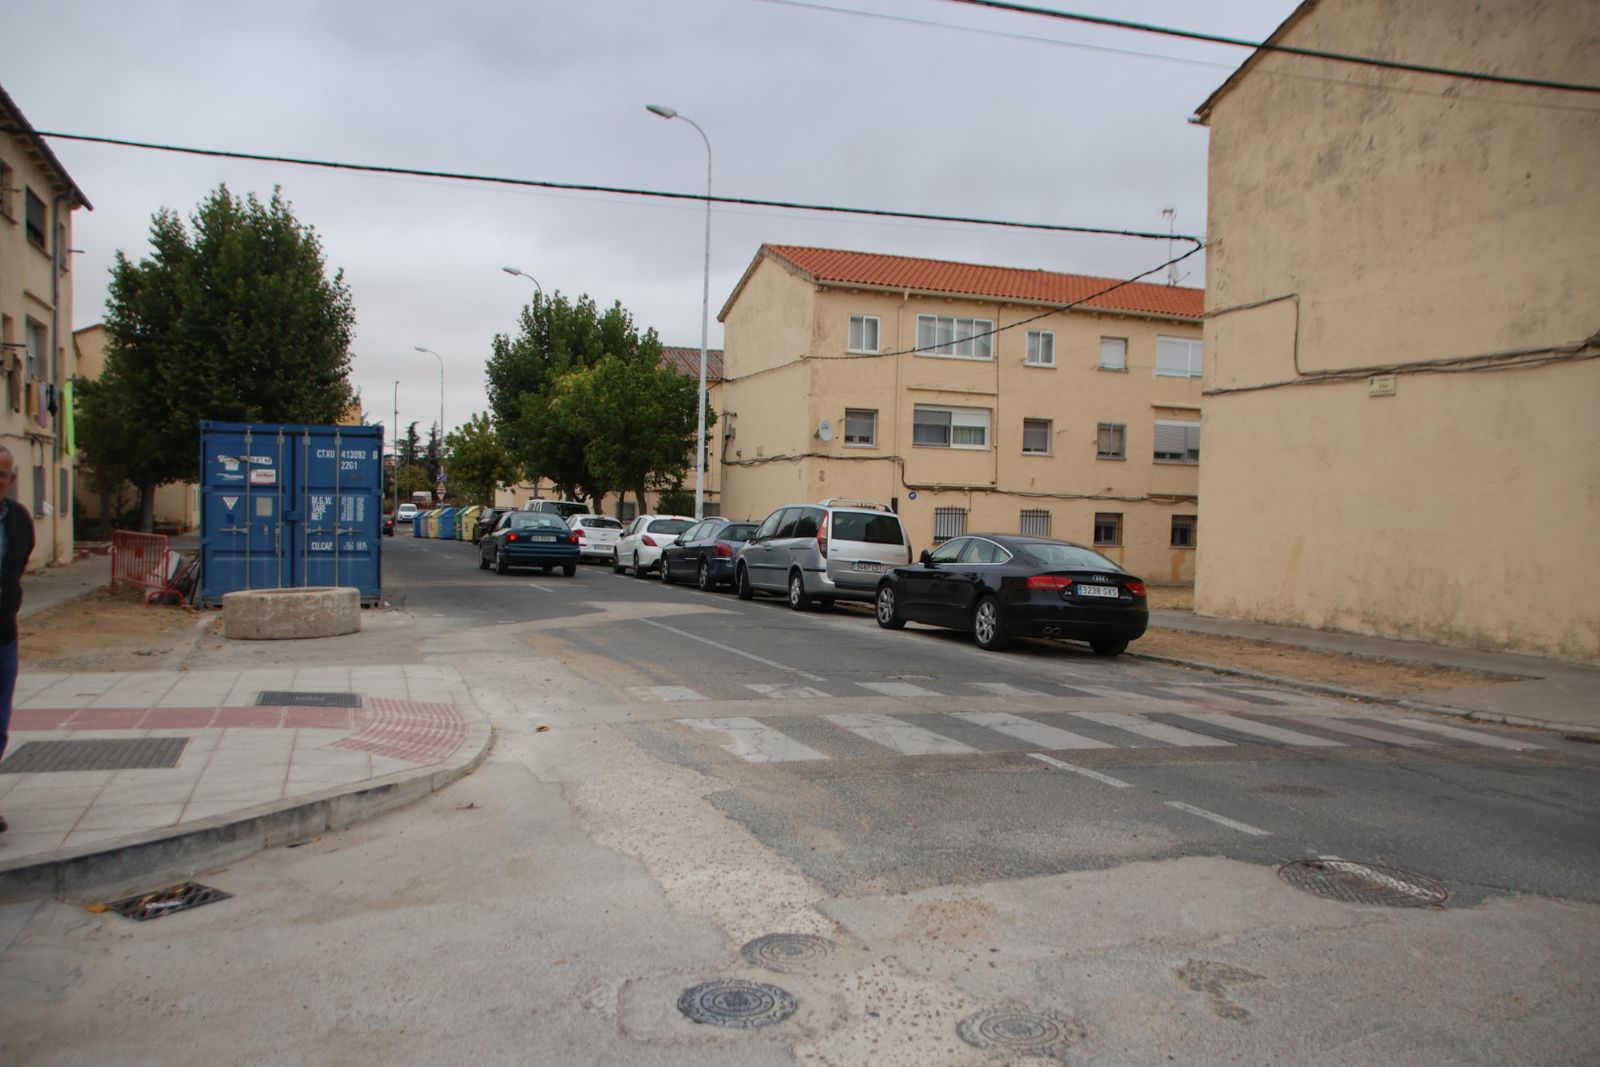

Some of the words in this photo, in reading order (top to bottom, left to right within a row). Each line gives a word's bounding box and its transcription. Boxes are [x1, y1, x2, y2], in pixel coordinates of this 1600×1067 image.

[316, 449, 335, 458] CTXU
[341, 461, 358, 470] 22G1
[311, 512, 323, 521] NET
[1082, 586, 1101, 595] 3238
